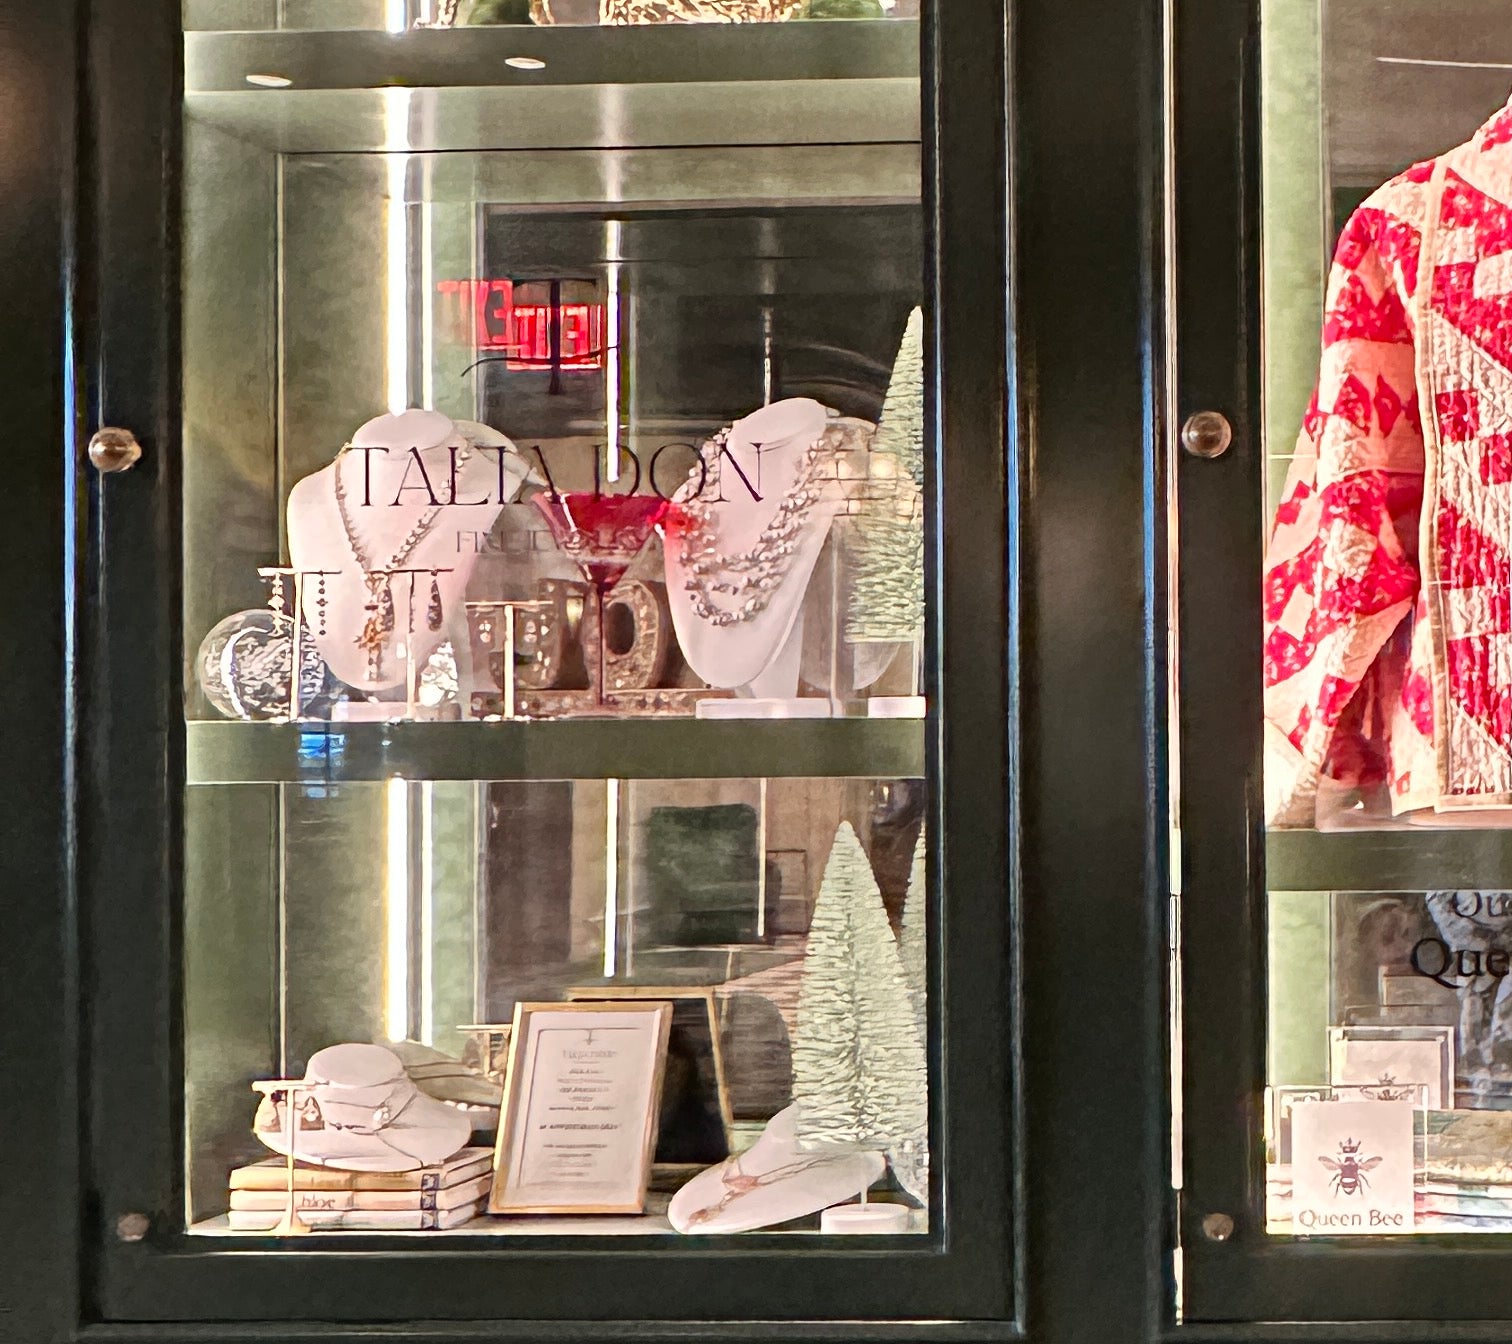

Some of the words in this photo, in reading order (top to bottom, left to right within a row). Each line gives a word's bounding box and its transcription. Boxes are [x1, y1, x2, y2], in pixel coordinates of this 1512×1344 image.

[346, 445, 562, 506] TALIA
[591, 442, 764, 503] DON
[1299, 1209, 1362, 1229] Queen
[1369, 1209, 1404, 1227] Bee
